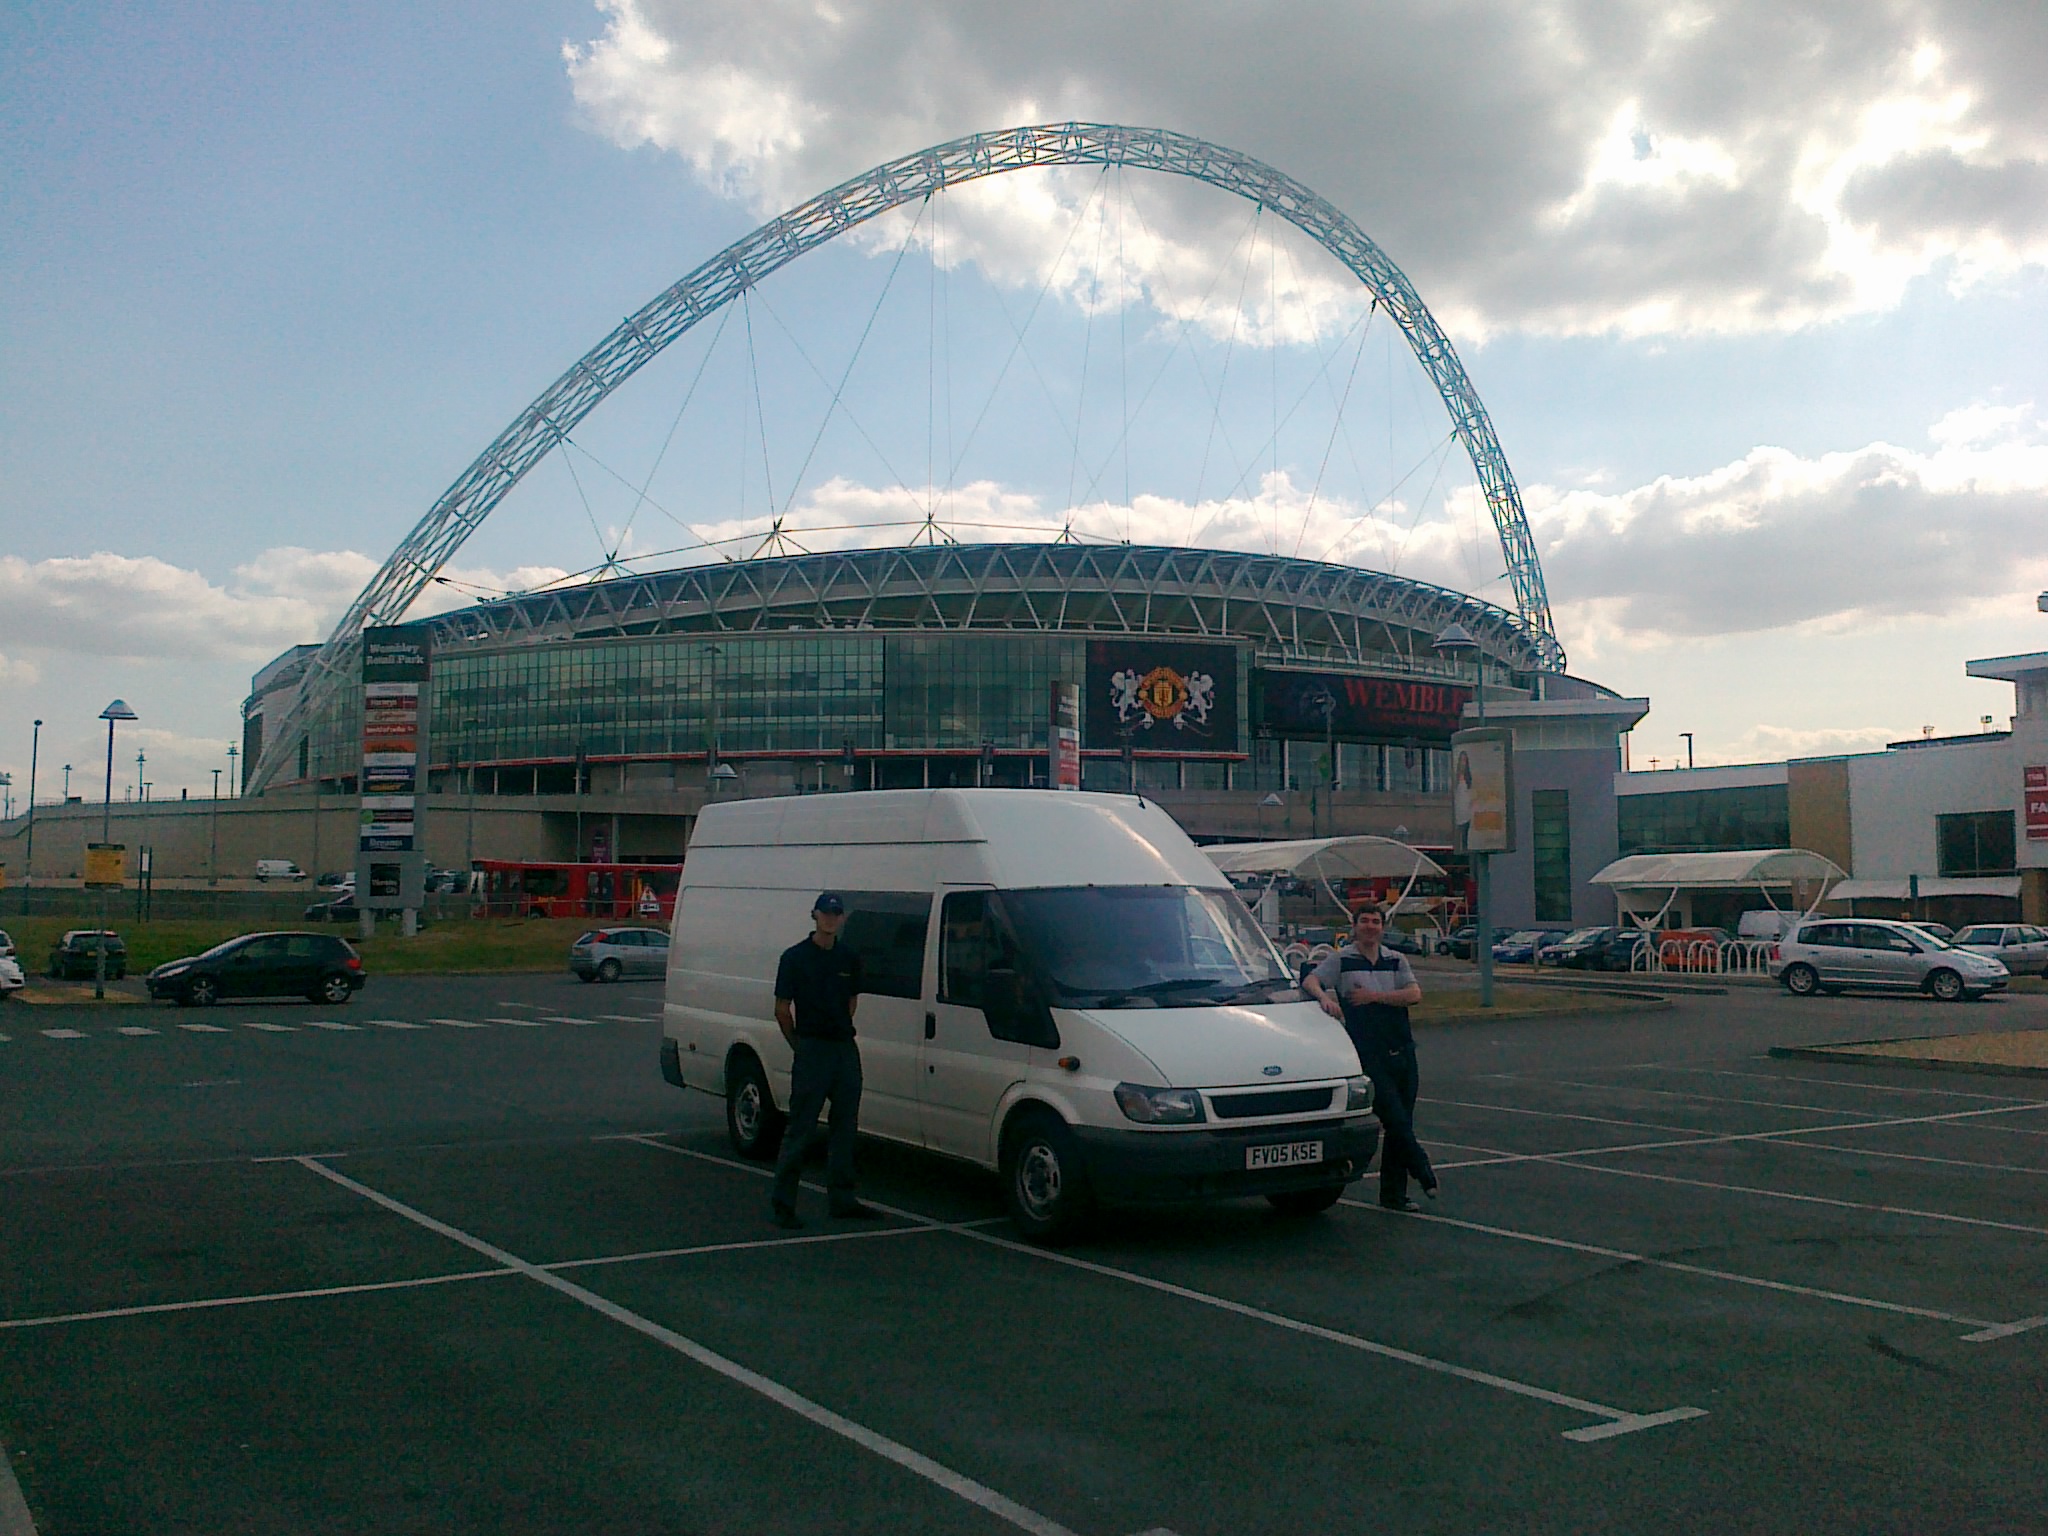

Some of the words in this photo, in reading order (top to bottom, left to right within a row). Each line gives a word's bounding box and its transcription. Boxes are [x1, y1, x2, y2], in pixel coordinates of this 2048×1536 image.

[396, 654, 424, 665] Park
[1344, 678, 1473, 715] WEMBLE
[1252, 1146, 1288, 1165] FV05
[1291, 1143, 1317, 1161] KSE
